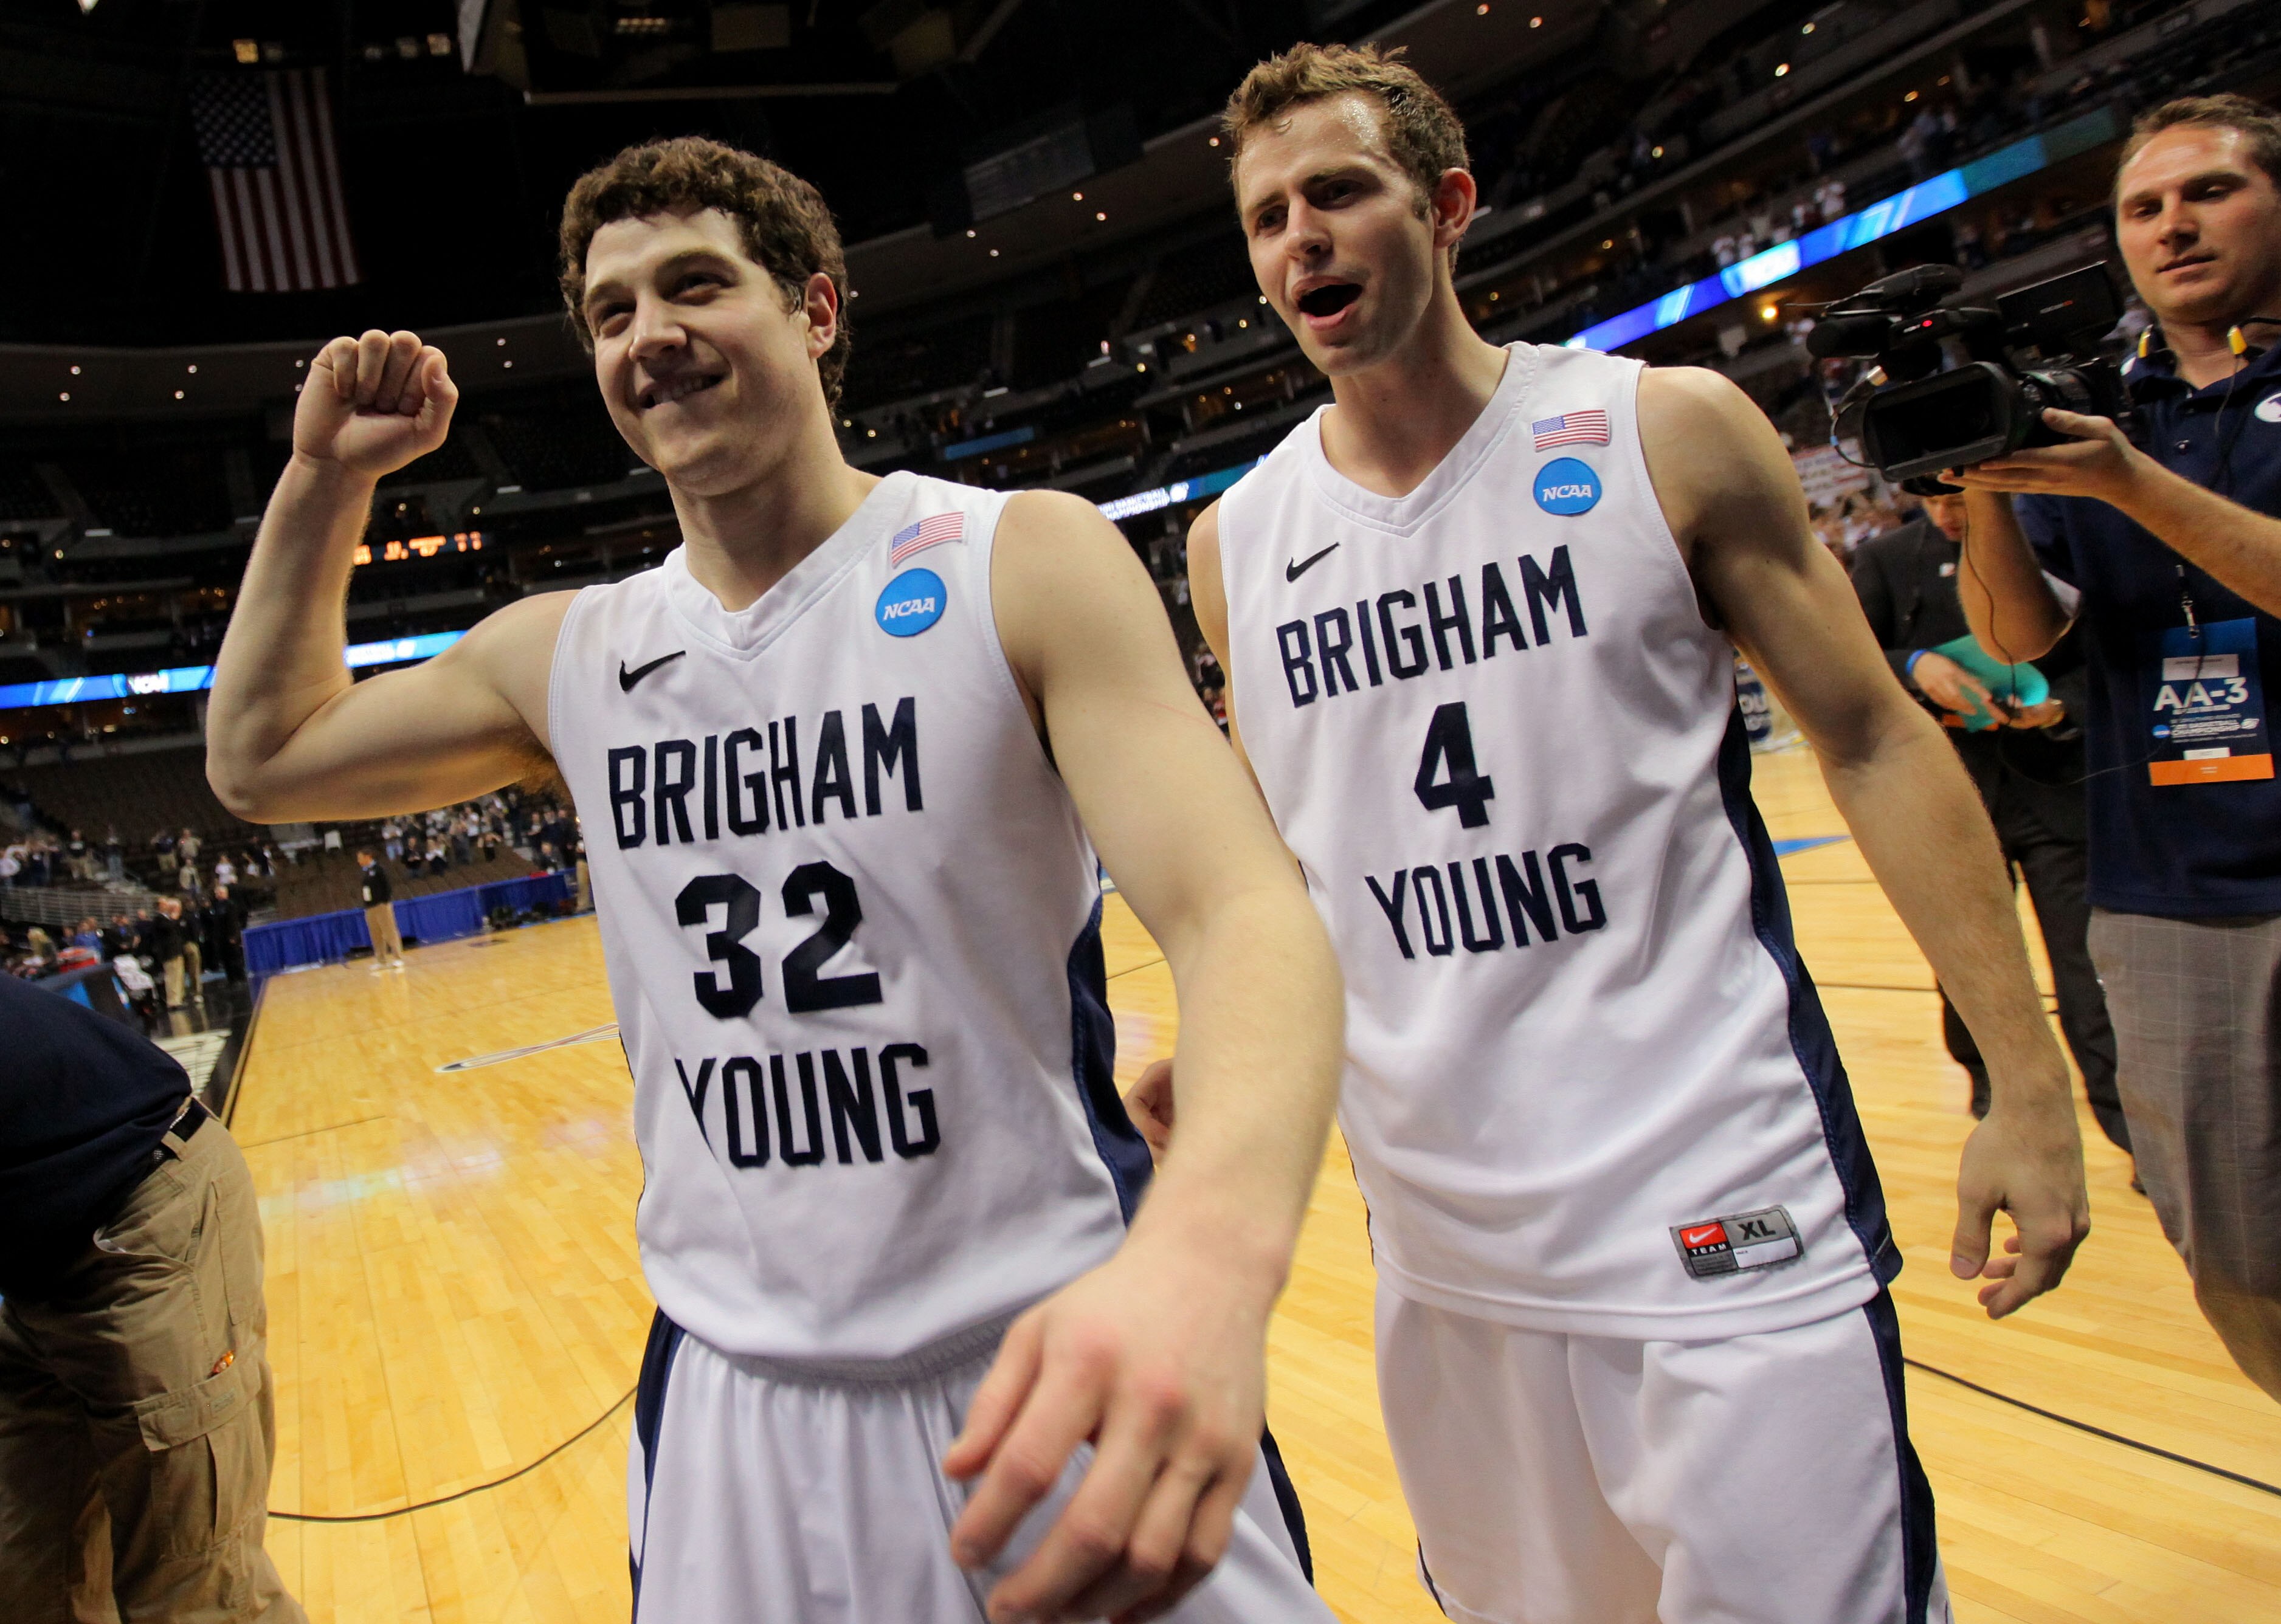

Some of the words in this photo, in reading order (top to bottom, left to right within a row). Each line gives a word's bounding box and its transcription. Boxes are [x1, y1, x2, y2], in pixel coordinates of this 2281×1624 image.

[1105, 492, 1170, 521] HAMPIONSHIP
[1116, 487, 1165, 509] BASKETBALL
[1542, 484, 1593, 502] NCAA
[883, 597, 935, 621] NCAA
[1276, 545, 1588, 707] BRIGHAM
[2153, 677, 2249, 711] AA-3
[608, 696, 924, 850] BRIGHAM
[1414, 701, 1495, 829] 4
[1365, 842, 1607, 959] YOUNG
[675, 861, 884, 1020] 32
[674, 1043, 940, 1169] YOUNG
[1738, 1220, 1776, 1240] XL
[1691, 1243, 1727, 1255] TEAM
